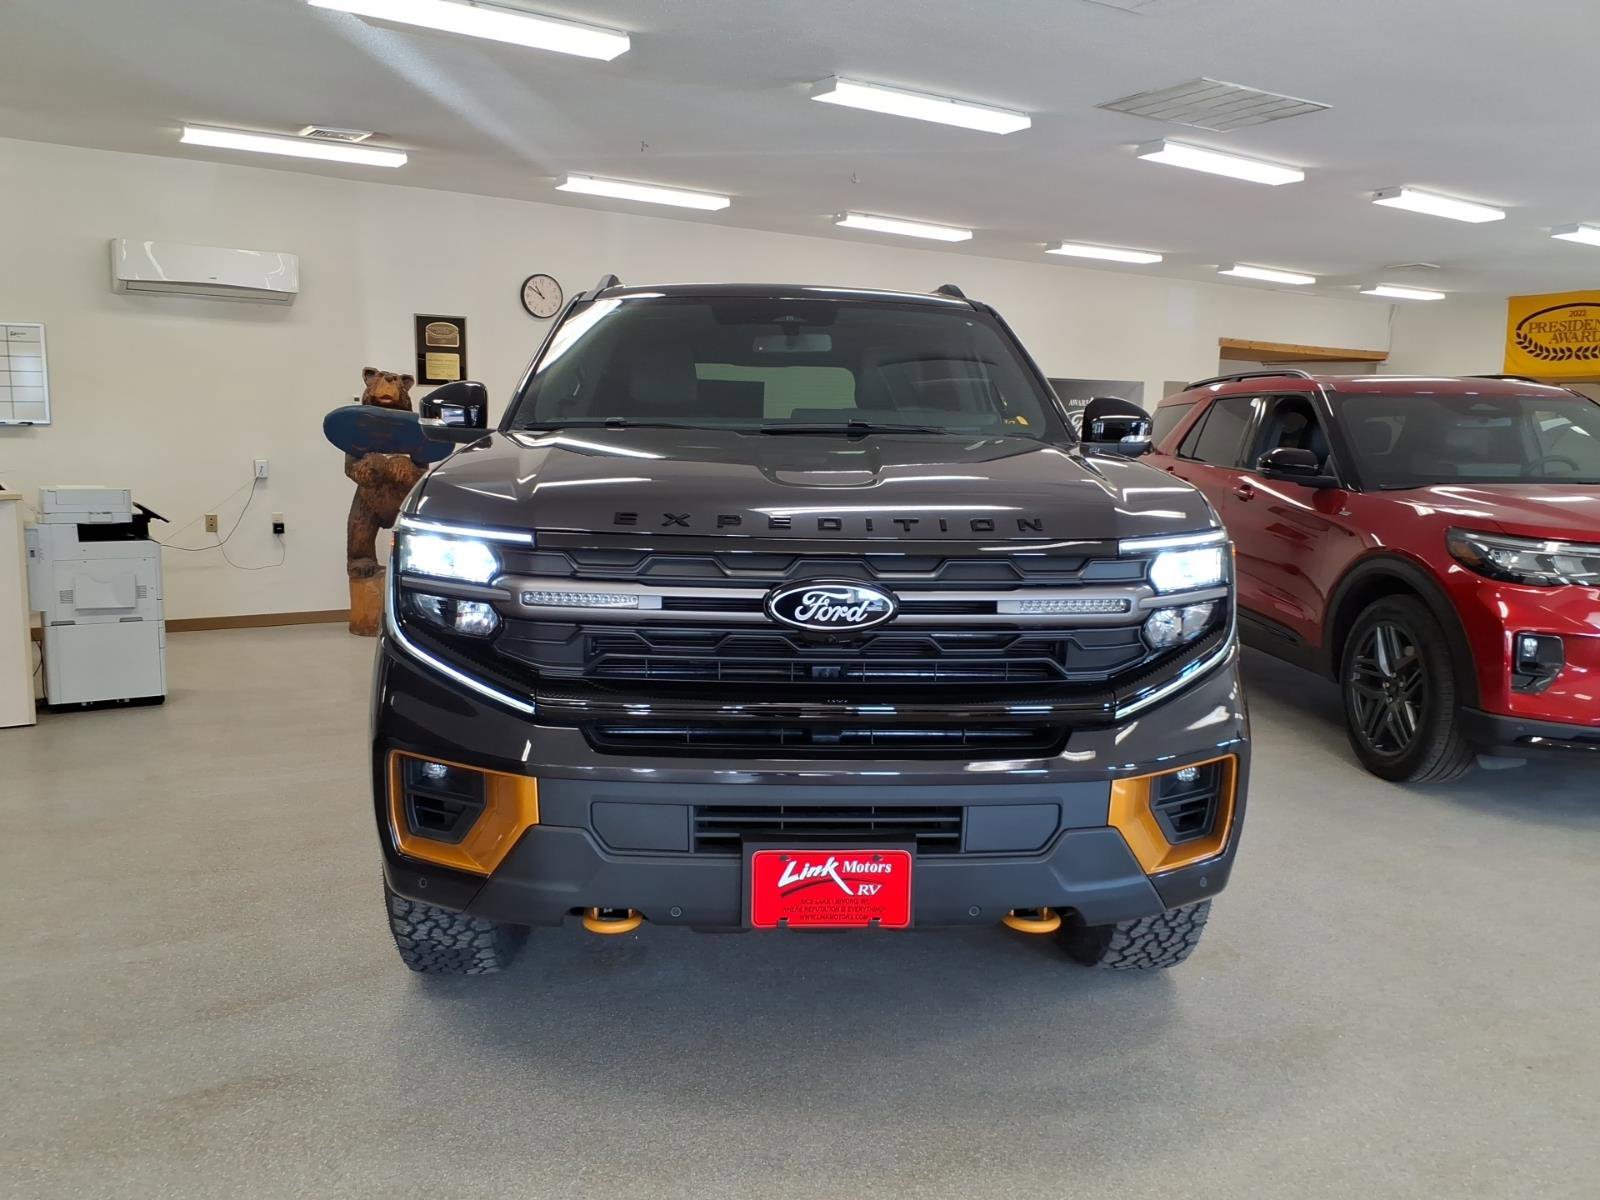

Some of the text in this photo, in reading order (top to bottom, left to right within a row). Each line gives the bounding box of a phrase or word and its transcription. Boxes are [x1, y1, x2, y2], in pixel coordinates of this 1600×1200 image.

[613, 511, 1044, 532] EXPEDITION
[794, 591, 870, 622] Ford
[777, 856, 892, 896] Link Motors
[857, 884, 882, 896] RV
